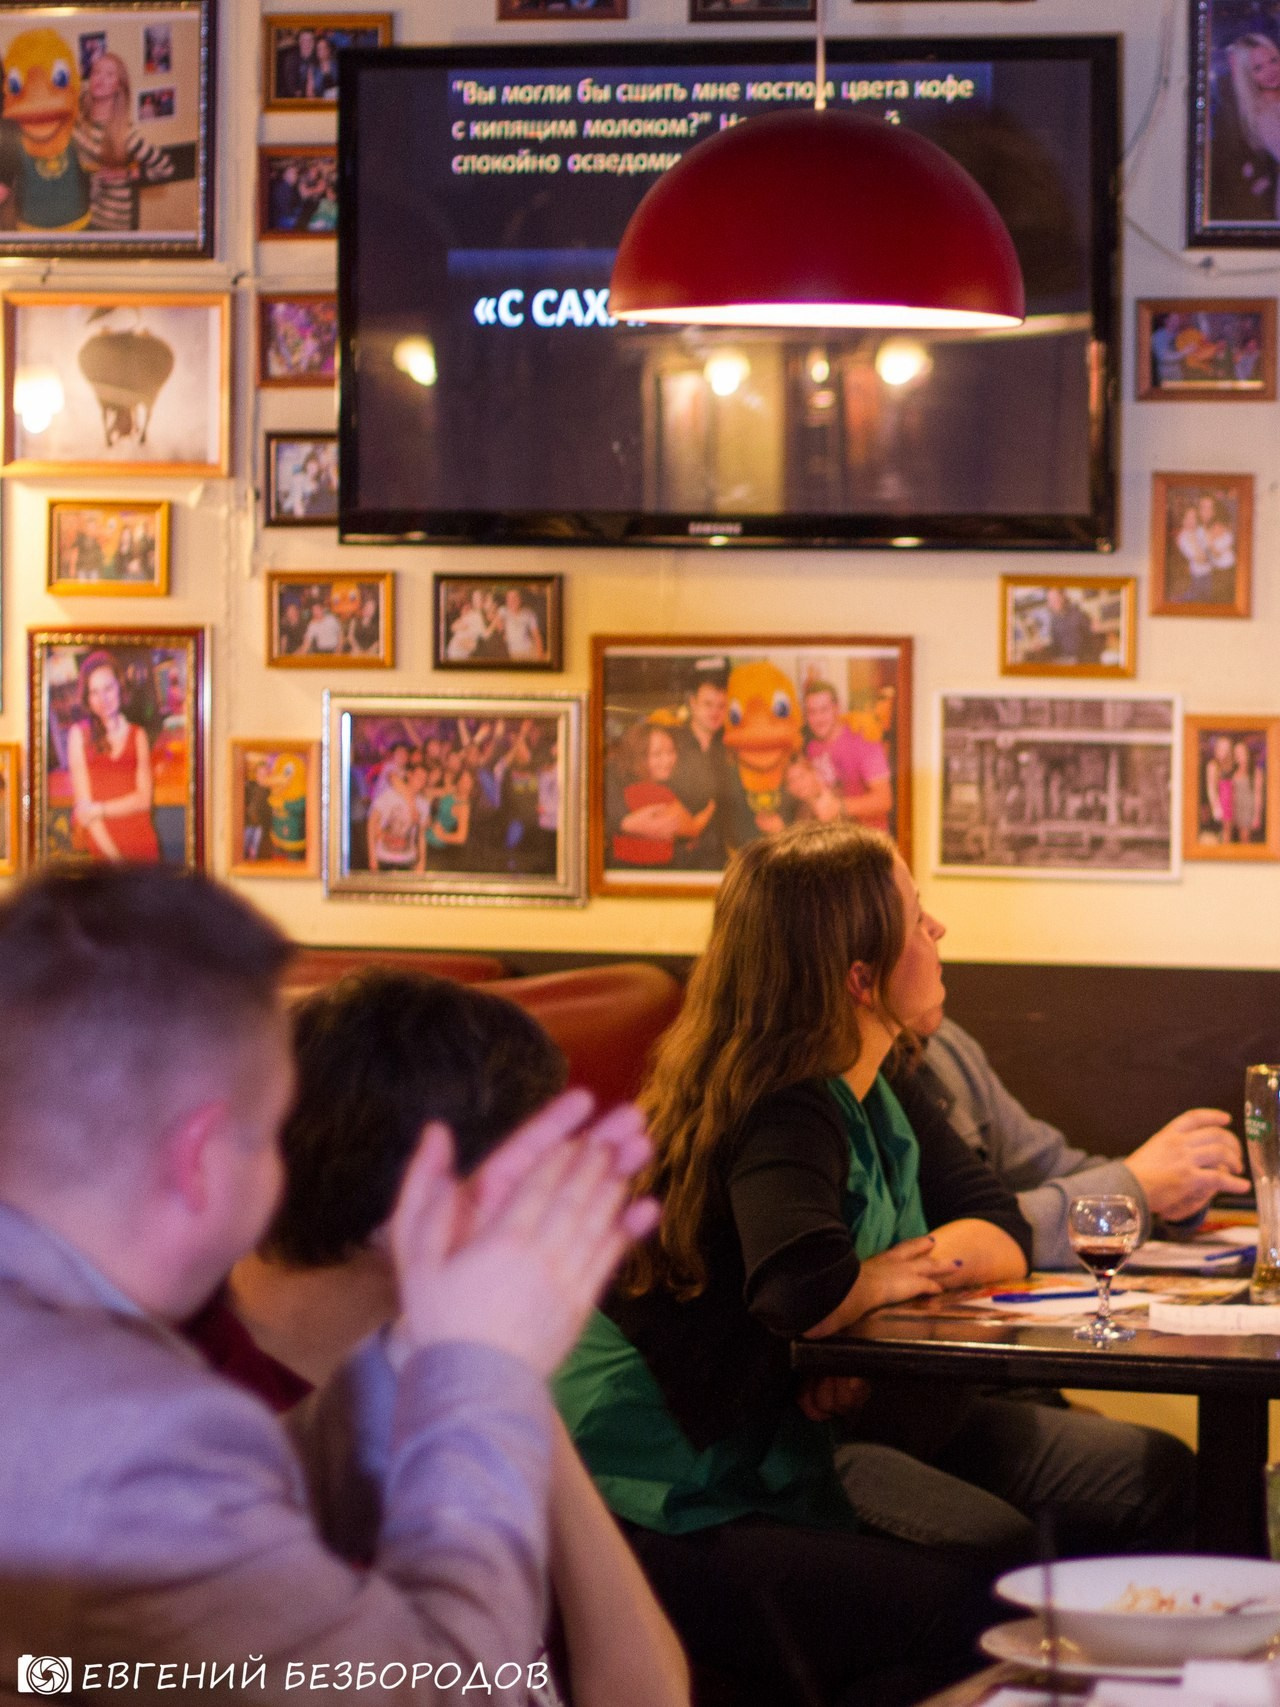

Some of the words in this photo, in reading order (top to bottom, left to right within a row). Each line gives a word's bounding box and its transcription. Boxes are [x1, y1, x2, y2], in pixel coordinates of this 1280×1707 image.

[502, 84, 572, 104] могли
[577, 77, 611, 103] бы
[616, 82, 688, 103] сшить
[691, 81, 740, 102] мне
[841, 79, 909, 104] цвета
[914, 73, 974, 104] кофе
[451, 120, 466, 140] с
[469, 119, 578, 143] кипящим
[451, 148, 562, 174] спокойно
[567, 153, 682, 176] осведоми
